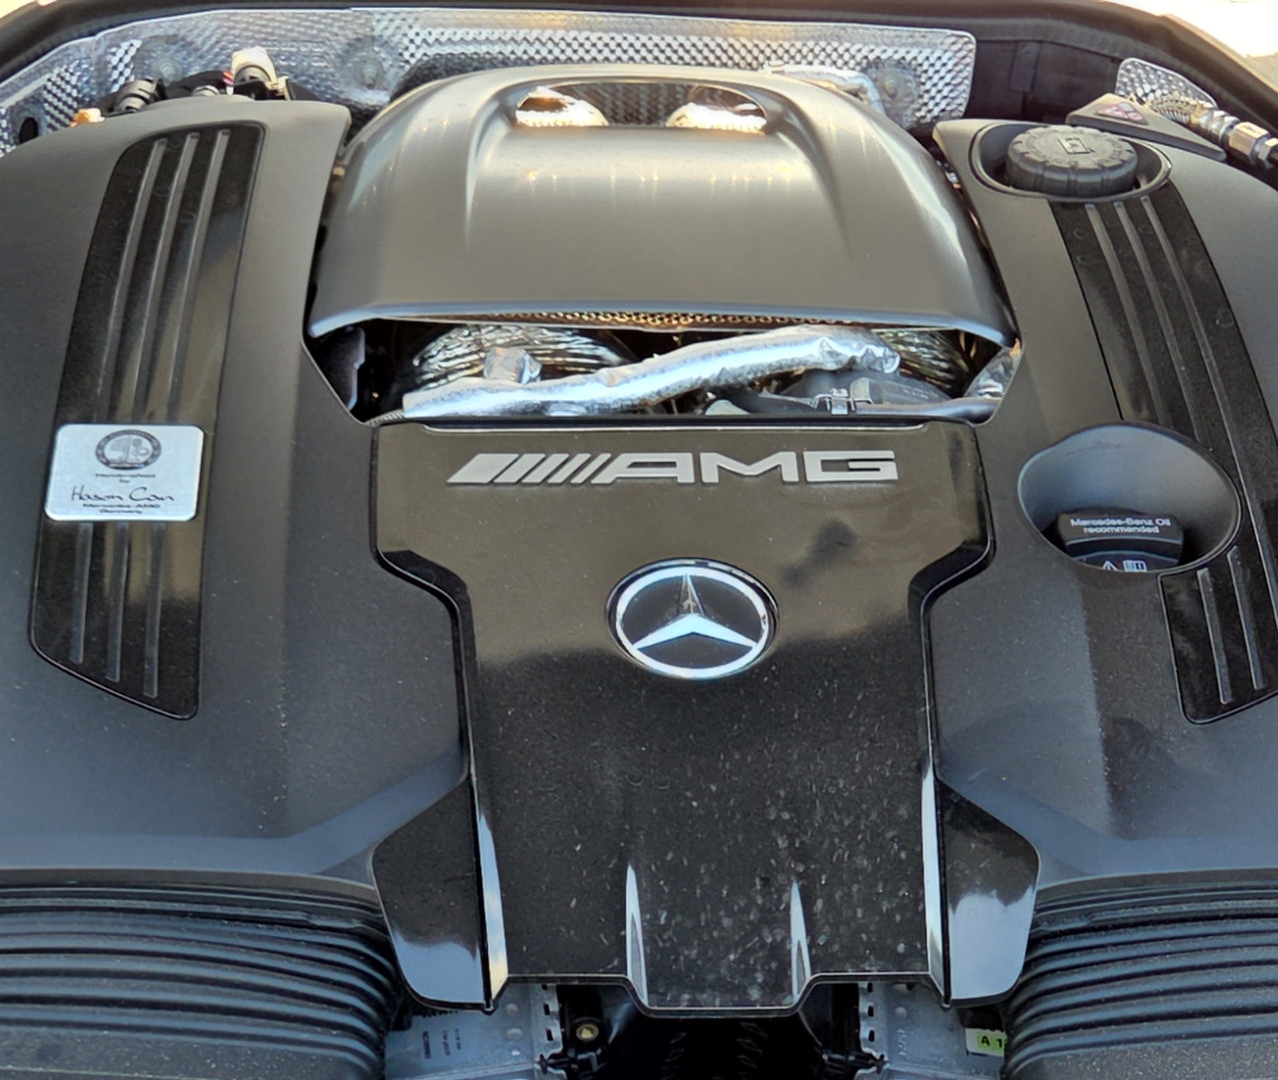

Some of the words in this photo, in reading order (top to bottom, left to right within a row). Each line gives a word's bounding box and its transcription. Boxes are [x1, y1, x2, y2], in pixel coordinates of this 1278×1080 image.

[590, 450, 899, 484] AMG
[1070, 517, 1153, 527] Mercedes-Benz
[1083, 525, 1159, 534] recommended
